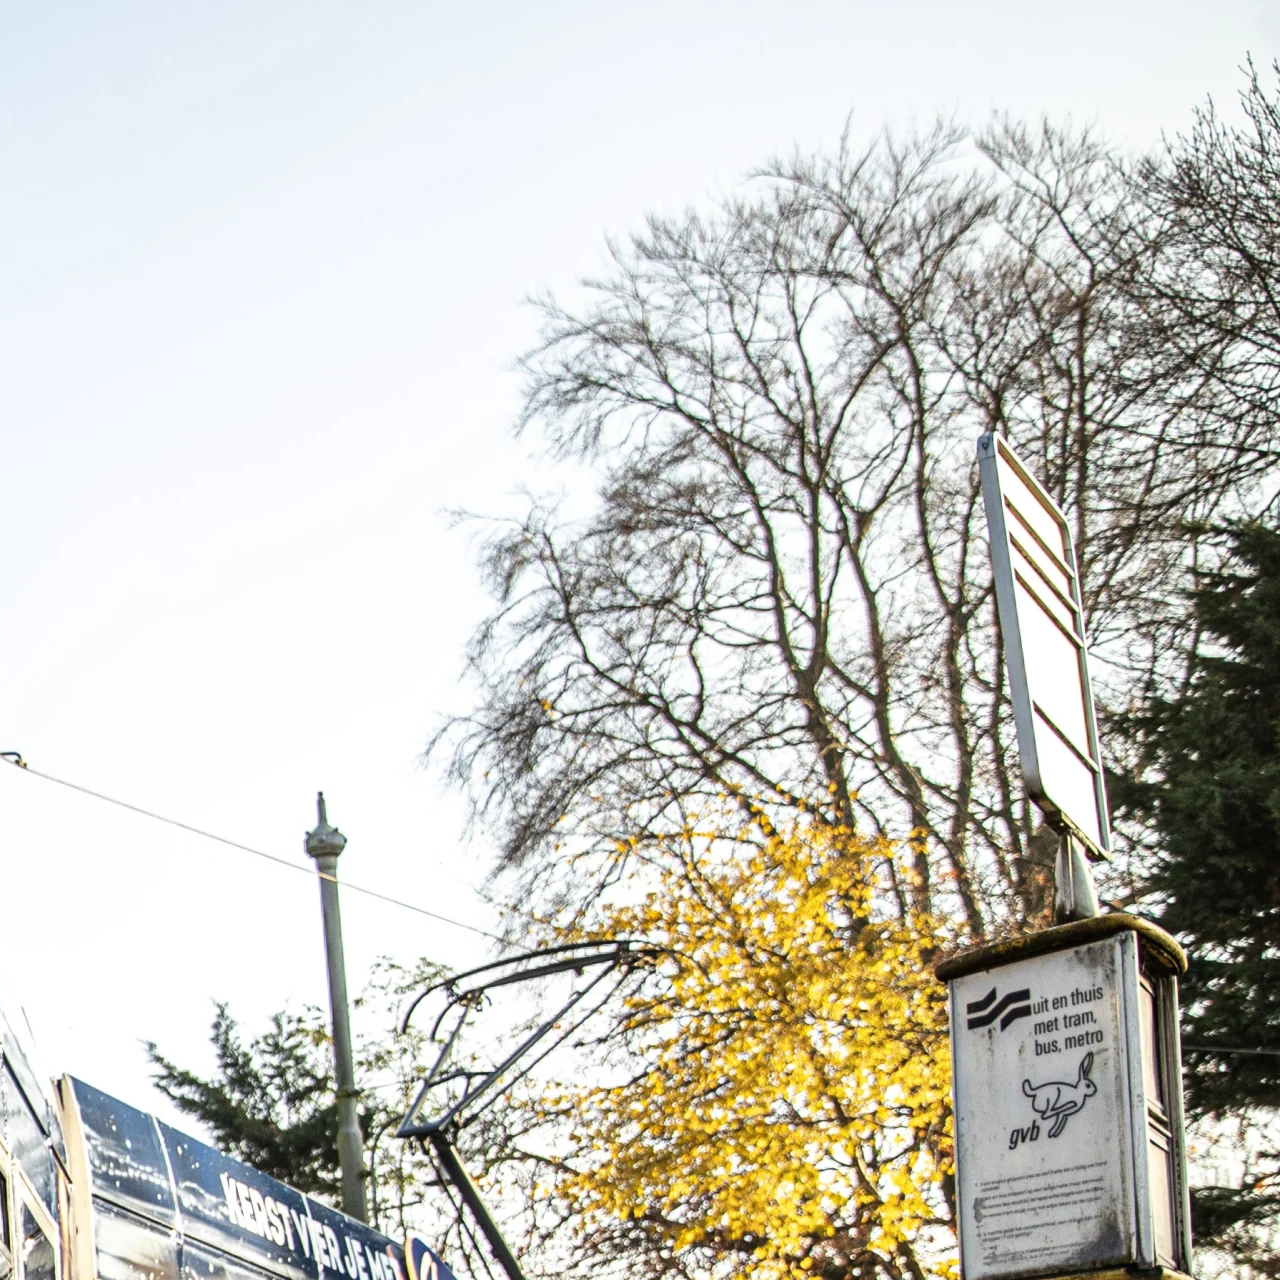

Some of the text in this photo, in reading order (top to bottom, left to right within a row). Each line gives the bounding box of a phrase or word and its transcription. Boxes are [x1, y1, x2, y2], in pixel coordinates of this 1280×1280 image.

[1032, 984, 1104, 1015] uit en thuis
[1034, 1010, 1097, 1035] met tram,
[1035, 1029, 1104, 1056] bus, metro
[1009, 1119, 1041, 1150] gvb
[220, 1171, 296, 1251] KERST
[289, 1209, 344, 1273] VIER
